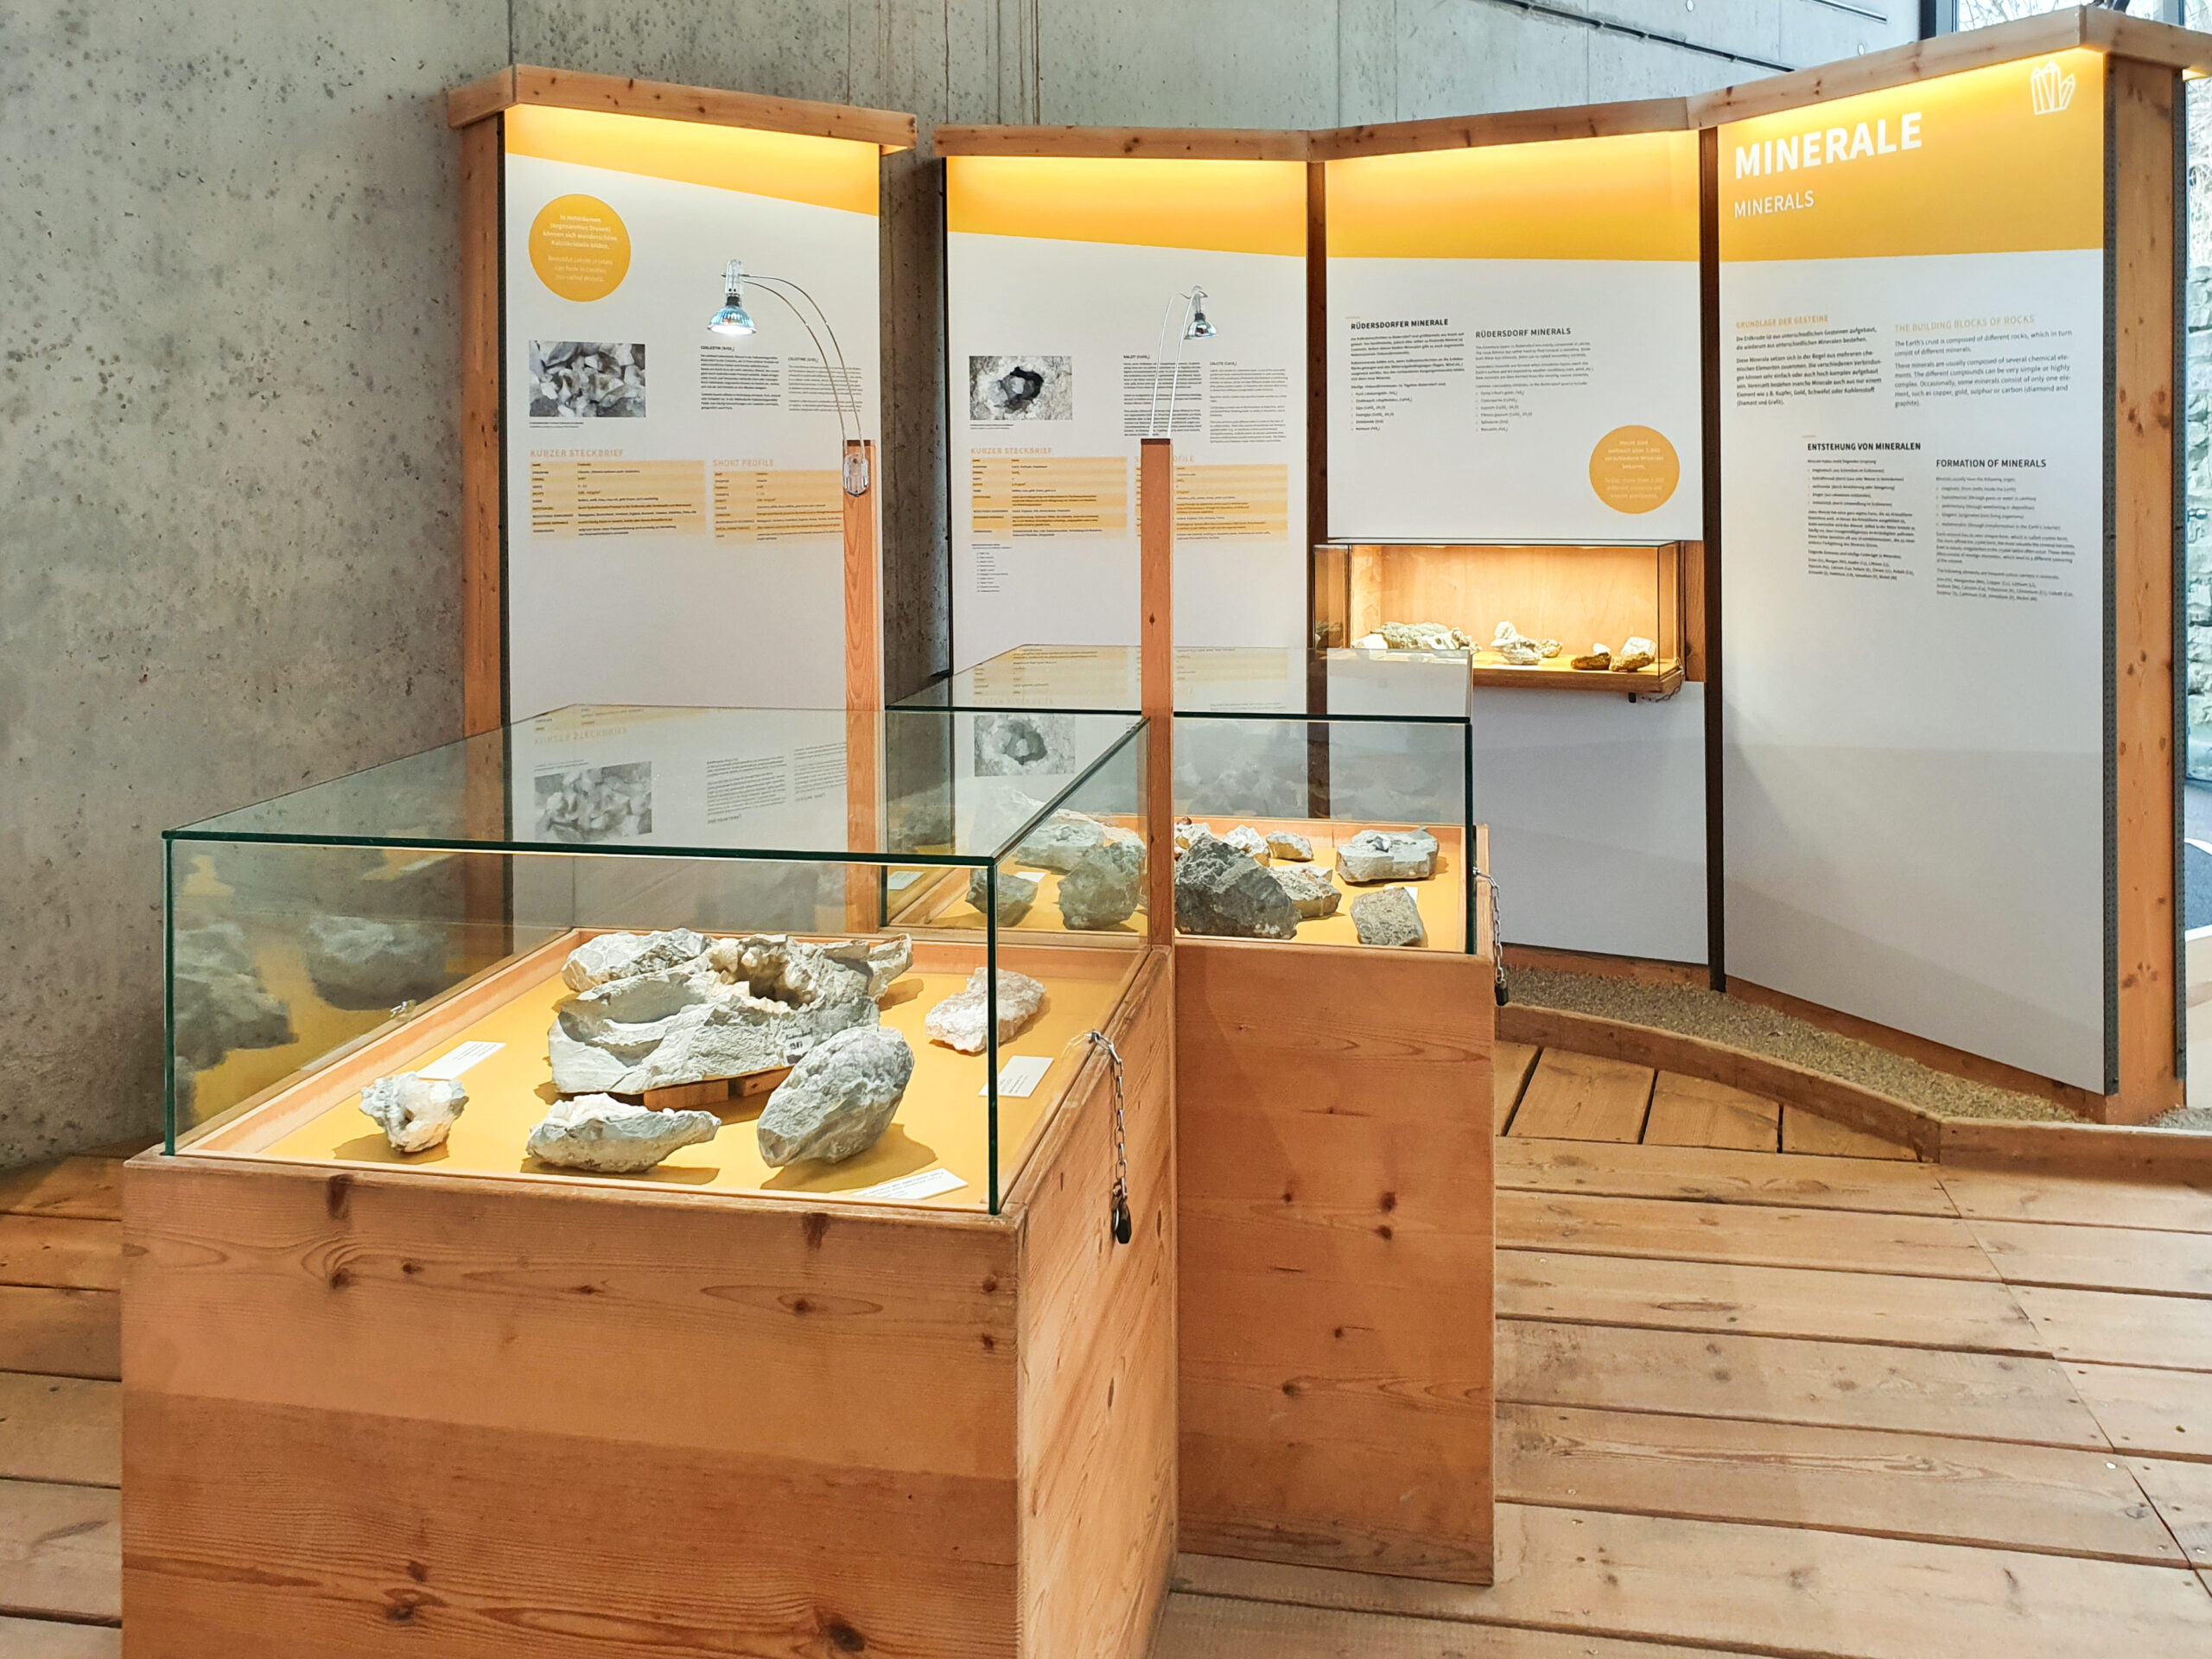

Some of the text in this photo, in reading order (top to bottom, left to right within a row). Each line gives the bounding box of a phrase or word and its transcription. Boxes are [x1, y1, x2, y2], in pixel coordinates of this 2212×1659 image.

[1736, 112, 1922, 179] MINERALE
[1734, 191, 1814, 218] MINERALS
[1351, 321, 1408, 329] RÜDERSDORFER
[1736, 320, 1776, 328] GRUNDLAGE
[1795, 315, 1828, 324] GESTEINE
[1895, 315, 2035, 333] THE BUILDING BLOCKS OF ROCKS
[1476, 329, 1528, 338] RÜDERSDORF
[2001, 459, 2046, 467] MINERALS
